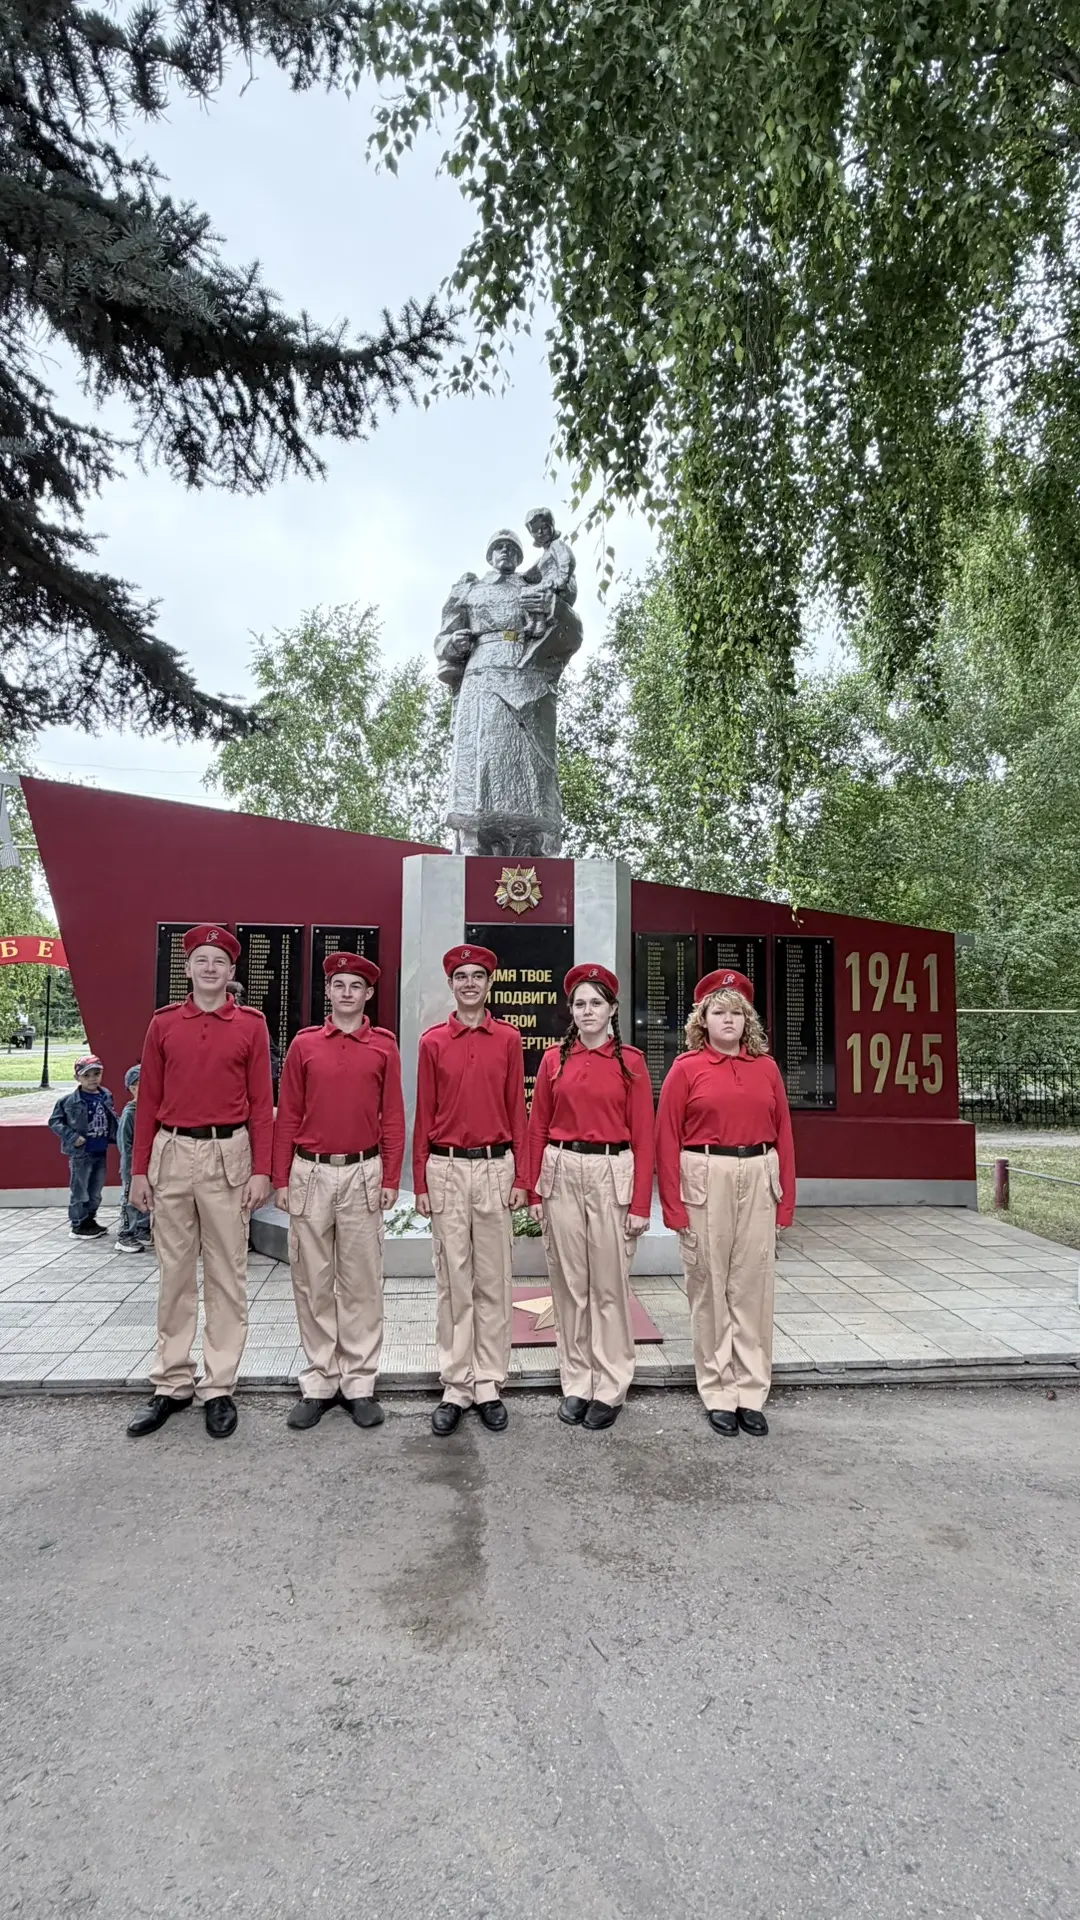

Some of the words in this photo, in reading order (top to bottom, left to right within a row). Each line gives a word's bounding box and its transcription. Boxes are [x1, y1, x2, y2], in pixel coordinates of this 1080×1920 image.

[520, 969, 553, 983] ТВОЕ
[845, 951, 939, 1012] 1941
[494, 991, 557, 1006] ПОДВИГИ
[502, 1014, 537, 1028] ТВОИ
[846, 1032, 943, 1094] 1945
